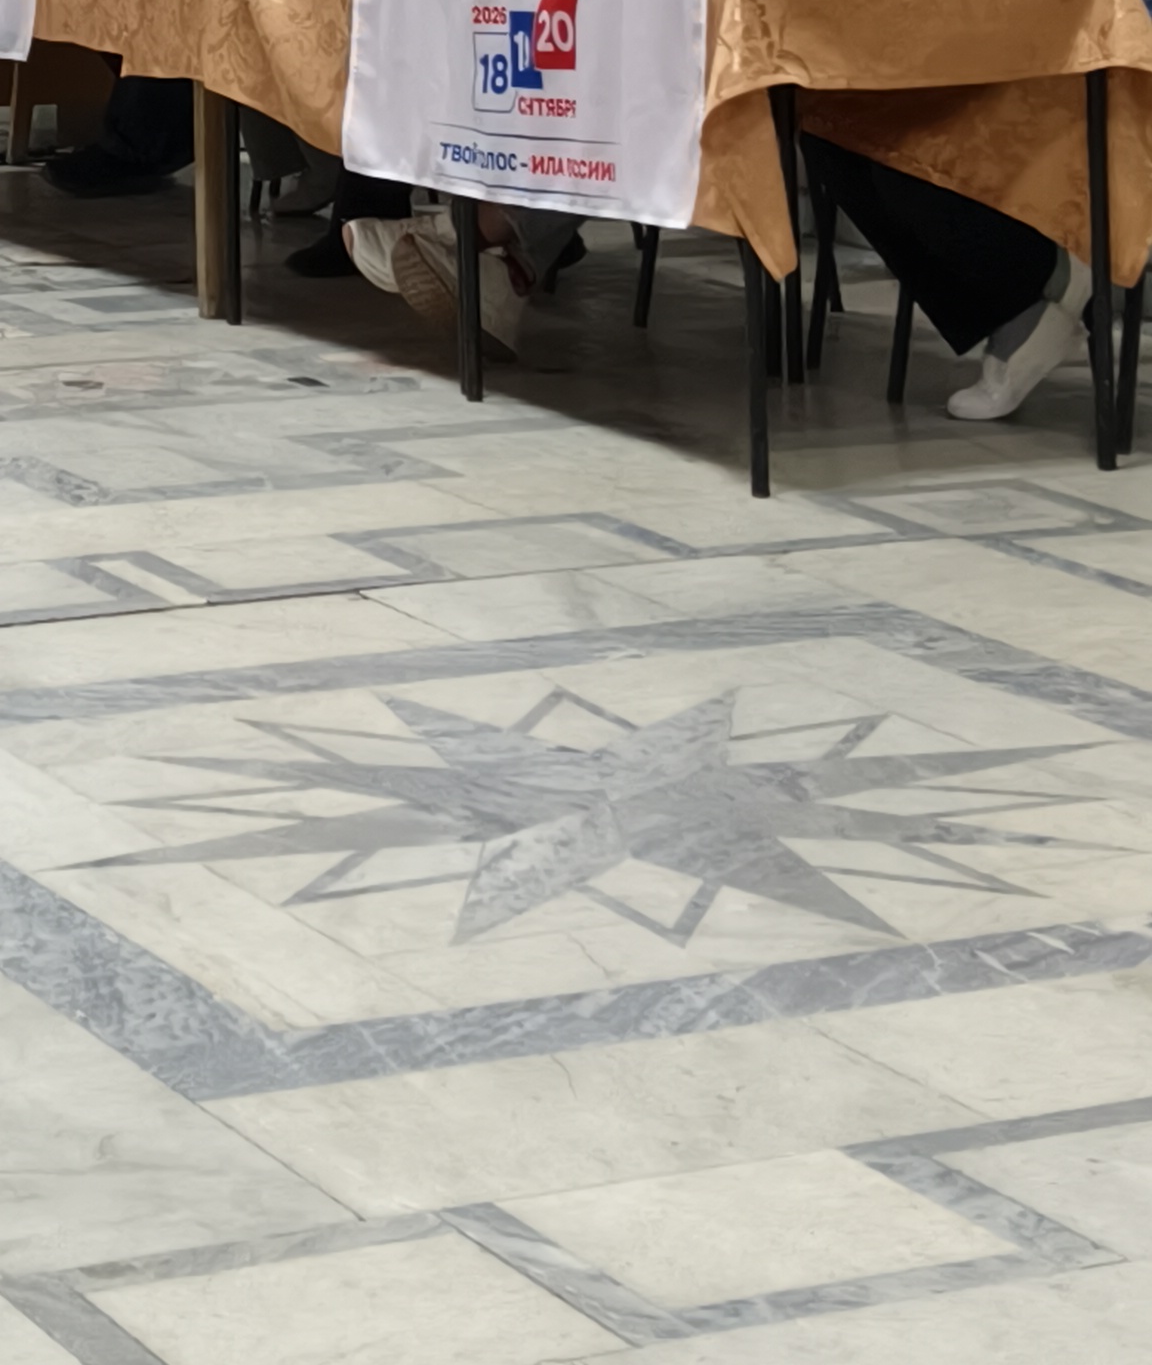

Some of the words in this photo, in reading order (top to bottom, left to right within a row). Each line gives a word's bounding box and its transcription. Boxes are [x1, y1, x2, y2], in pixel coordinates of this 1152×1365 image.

[471, 5, 507, 25] 2026
[536, 9, 575, 53] 20
[479, 53, 508, 95] 18
